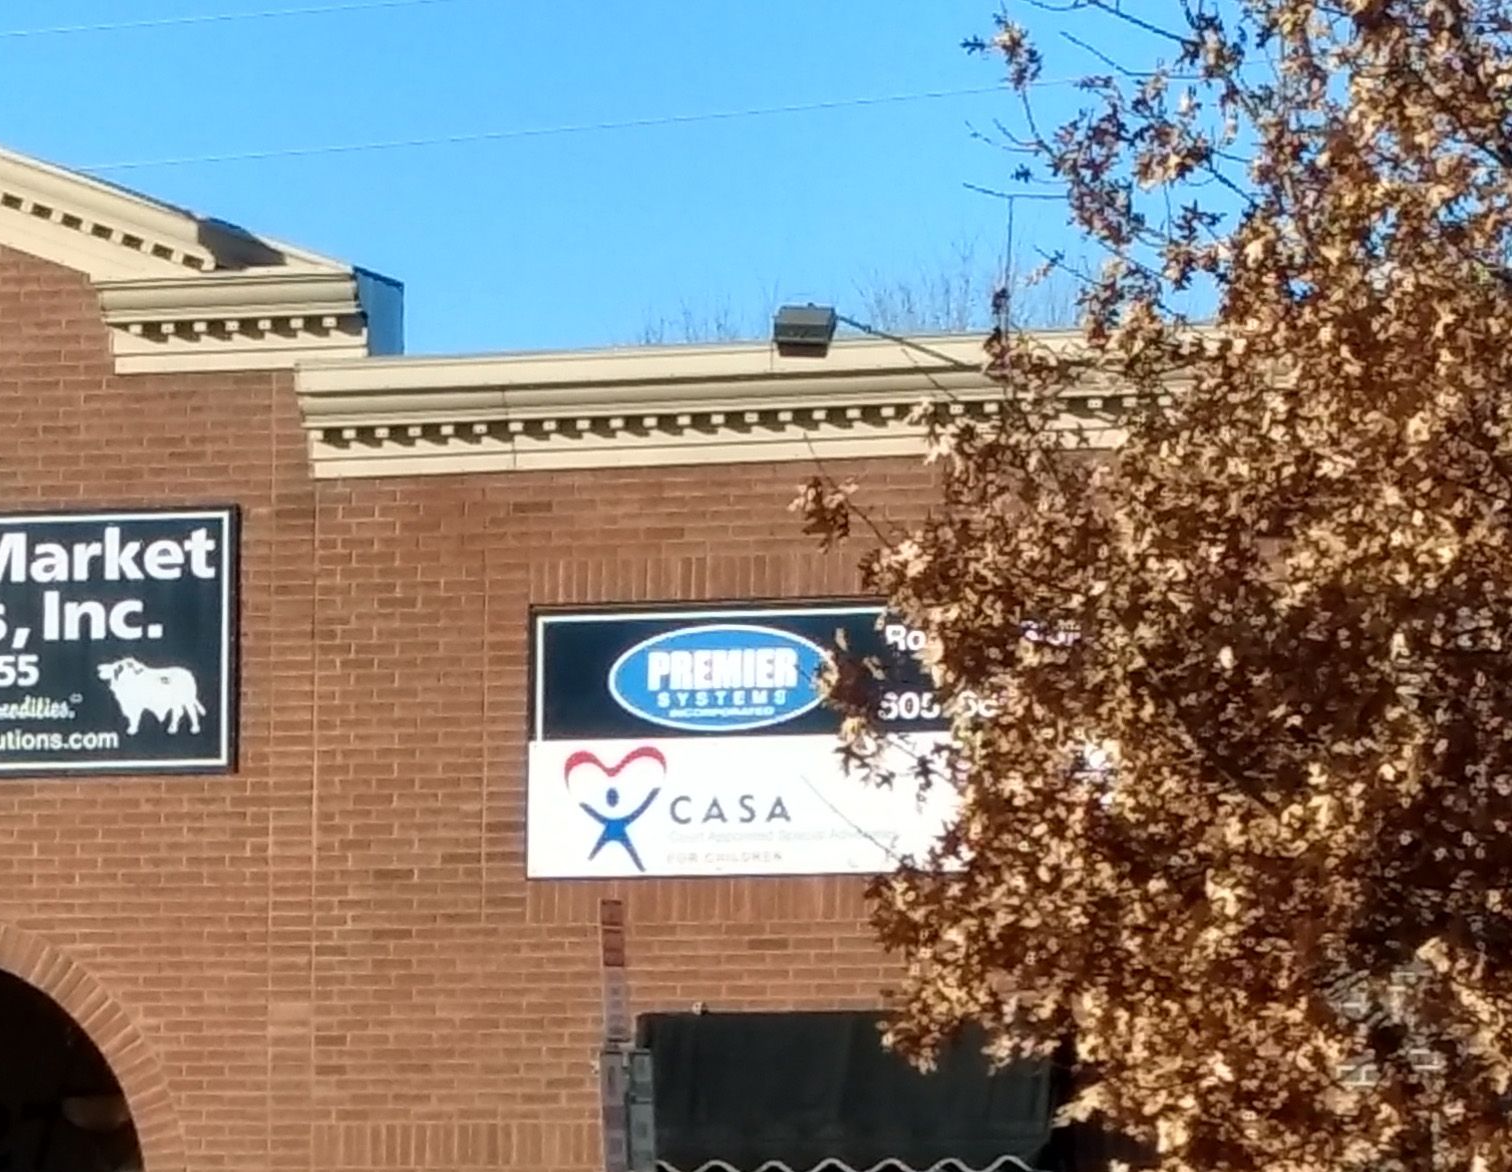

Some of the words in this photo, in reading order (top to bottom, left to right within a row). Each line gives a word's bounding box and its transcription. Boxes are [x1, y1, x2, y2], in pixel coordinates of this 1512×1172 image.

[43, 590, 163, 641] Inc.
[647, 647, 798, 691] PREMIER
[657, 690, 787, 708] SYSTEMS
[668, 706, 777, 718] INCORPORATED
[669, 795, 792, 825] CASA
